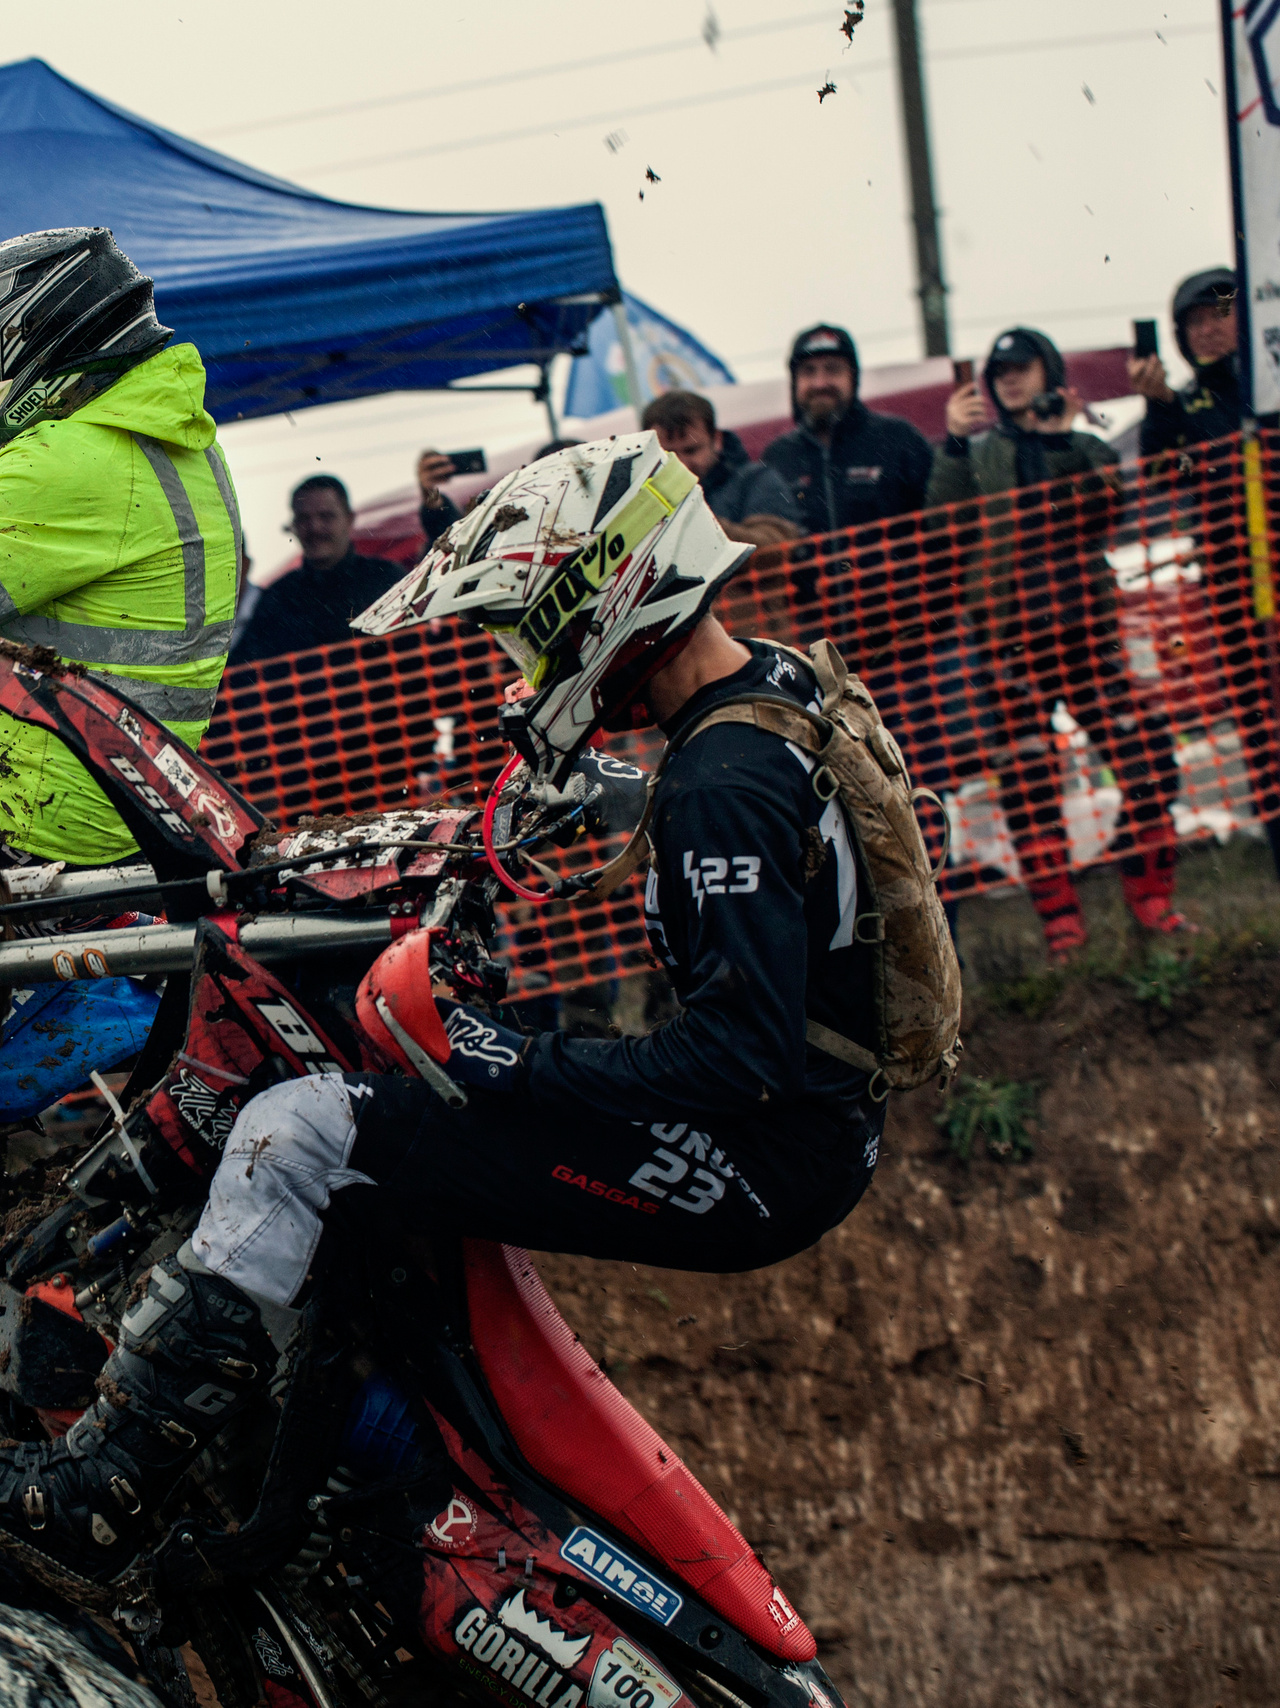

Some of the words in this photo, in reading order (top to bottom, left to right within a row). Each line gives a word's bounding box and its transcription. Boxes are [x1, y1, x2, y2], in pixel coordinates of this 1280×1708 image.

[8, 391, 44, 424] SHOEI
[551, 1164, 661, 1215] GASGAS
[628, 1147, 706, 1215] 23
[459, 1495, 479, 1535] CUSTOMS
[567, 1537, 669, 1620] AIMOL
[767, 1585, 794, 1627] #1
[455, 1607, 587, 1708] GORILLA
[458, 1658, 508, 1697] ENERGY
[601, 1662, 655, 1708] 100
